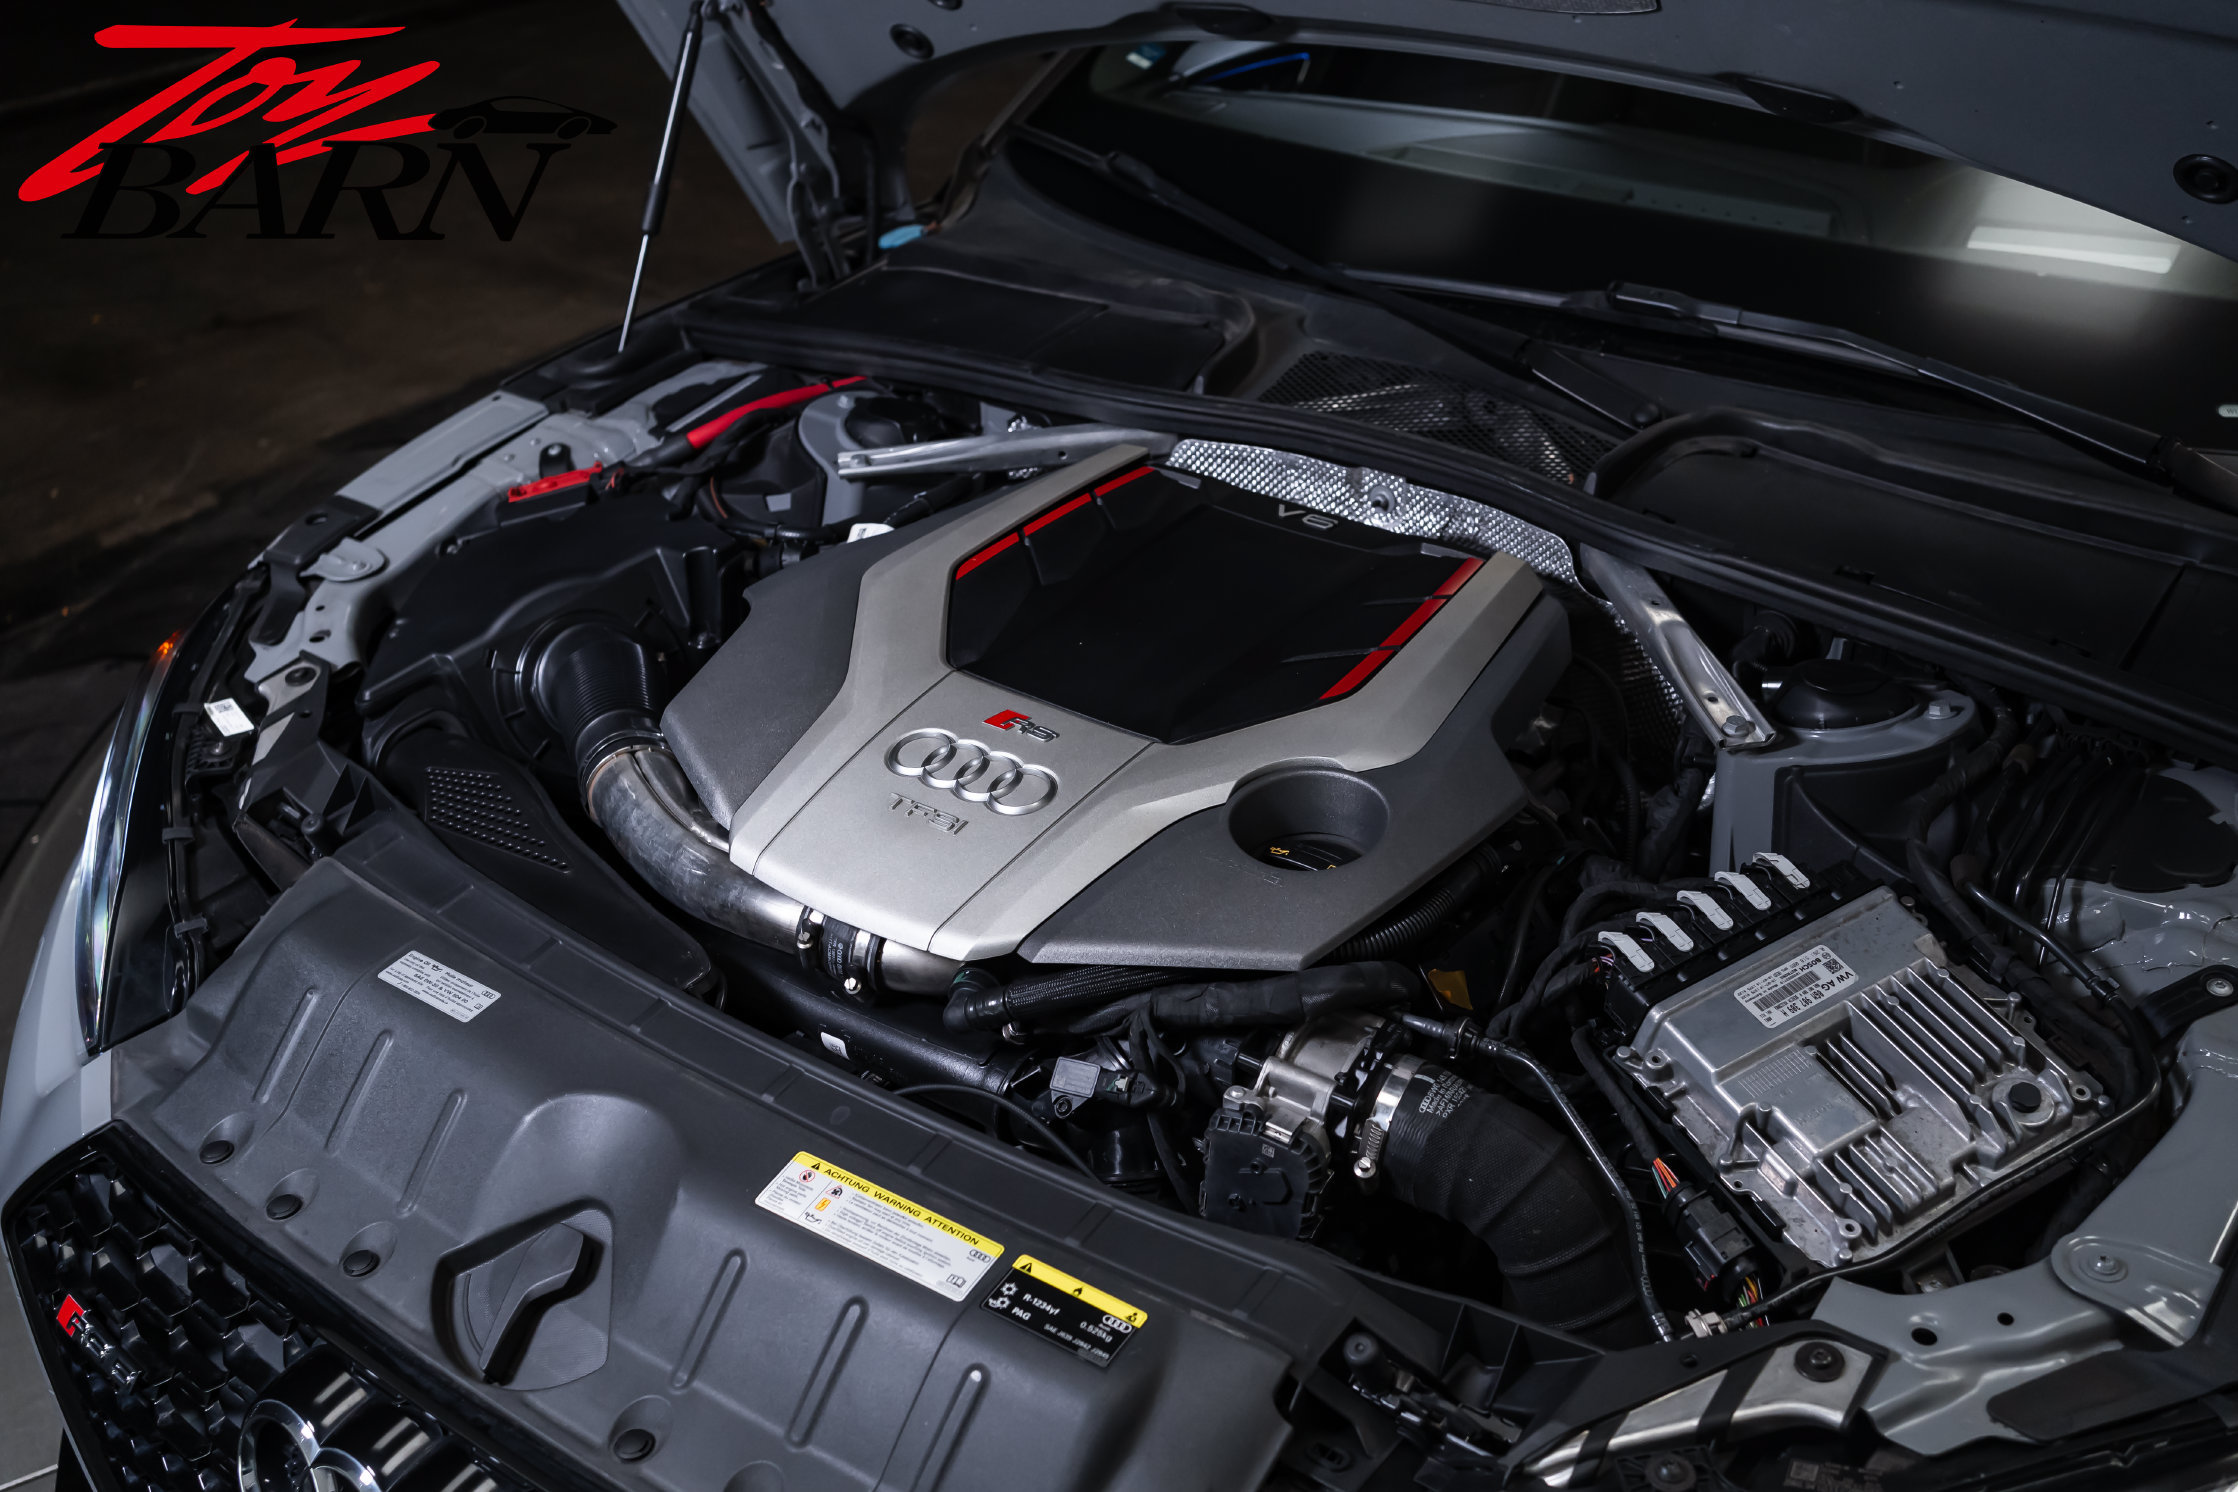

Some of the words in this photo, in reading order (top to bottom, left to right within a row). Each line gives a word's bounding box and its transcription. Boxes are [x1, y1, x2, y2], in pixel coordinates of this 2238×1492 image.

[1278, 503, 1339, 529] V6
[990, 711, 1060, 742] RS
[888, 791, 969, 836] TFSI
[1798, 957, 1822, 972] BOSCH
[1820, 979, 1836, 991] AG
[1837, 971, 1854, 984] VW
[824, 1167, 870, 1193] ACHTUNG
[873, 1191, 921, 1217] WARNING
[924, 1215, 979, 1246] ATTENTION
[1011, 1306, 1032, 1321] PAG
[1022, 1293, 1060, 1315] R-1234yf
